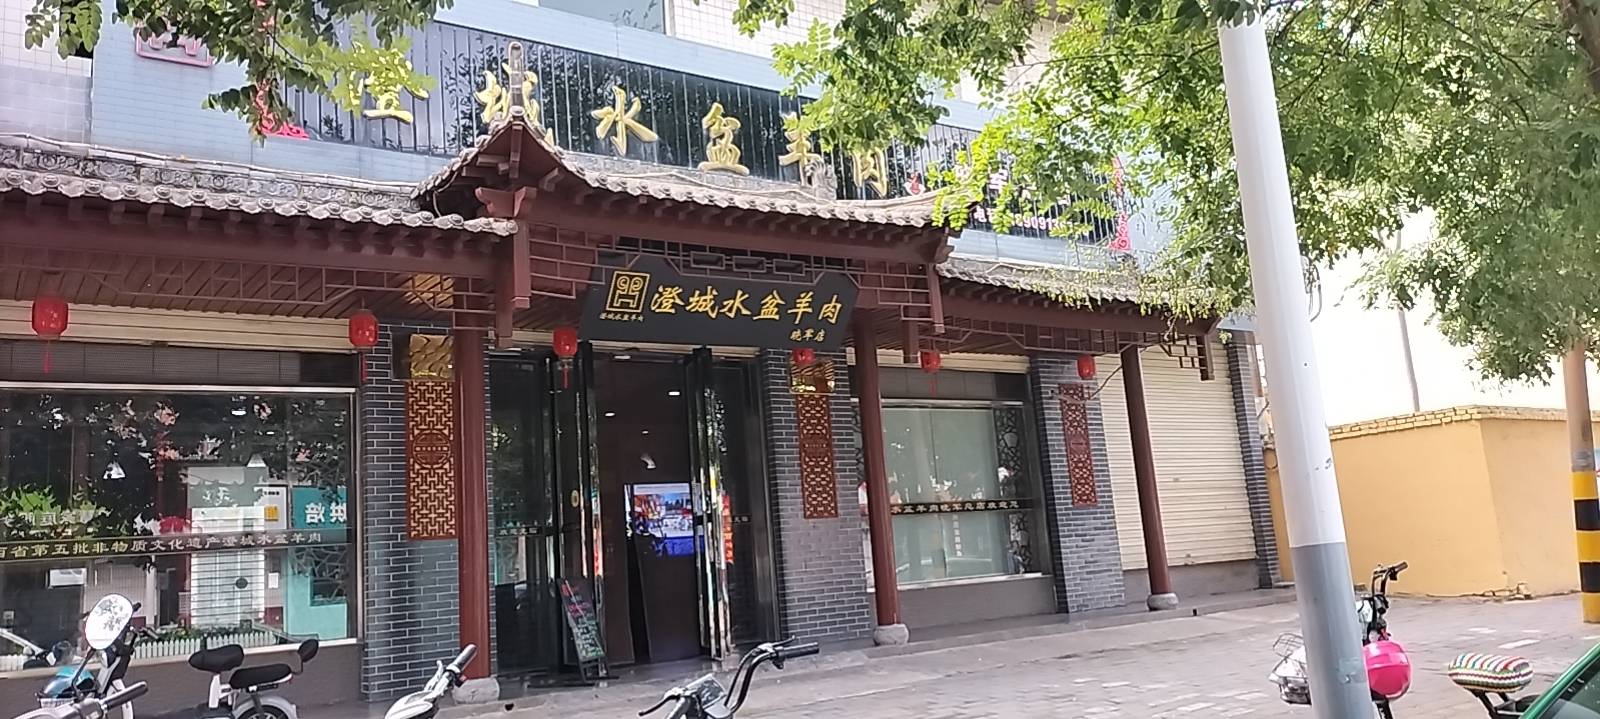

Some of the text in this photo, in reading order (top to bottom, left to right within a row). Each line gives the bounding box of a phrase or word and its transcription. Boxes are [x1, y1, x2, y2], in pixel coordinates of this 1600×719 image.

[651, 285, 842, 324] 澄城水盆羊肉
[789, 328, 826, 342] 晓军店
